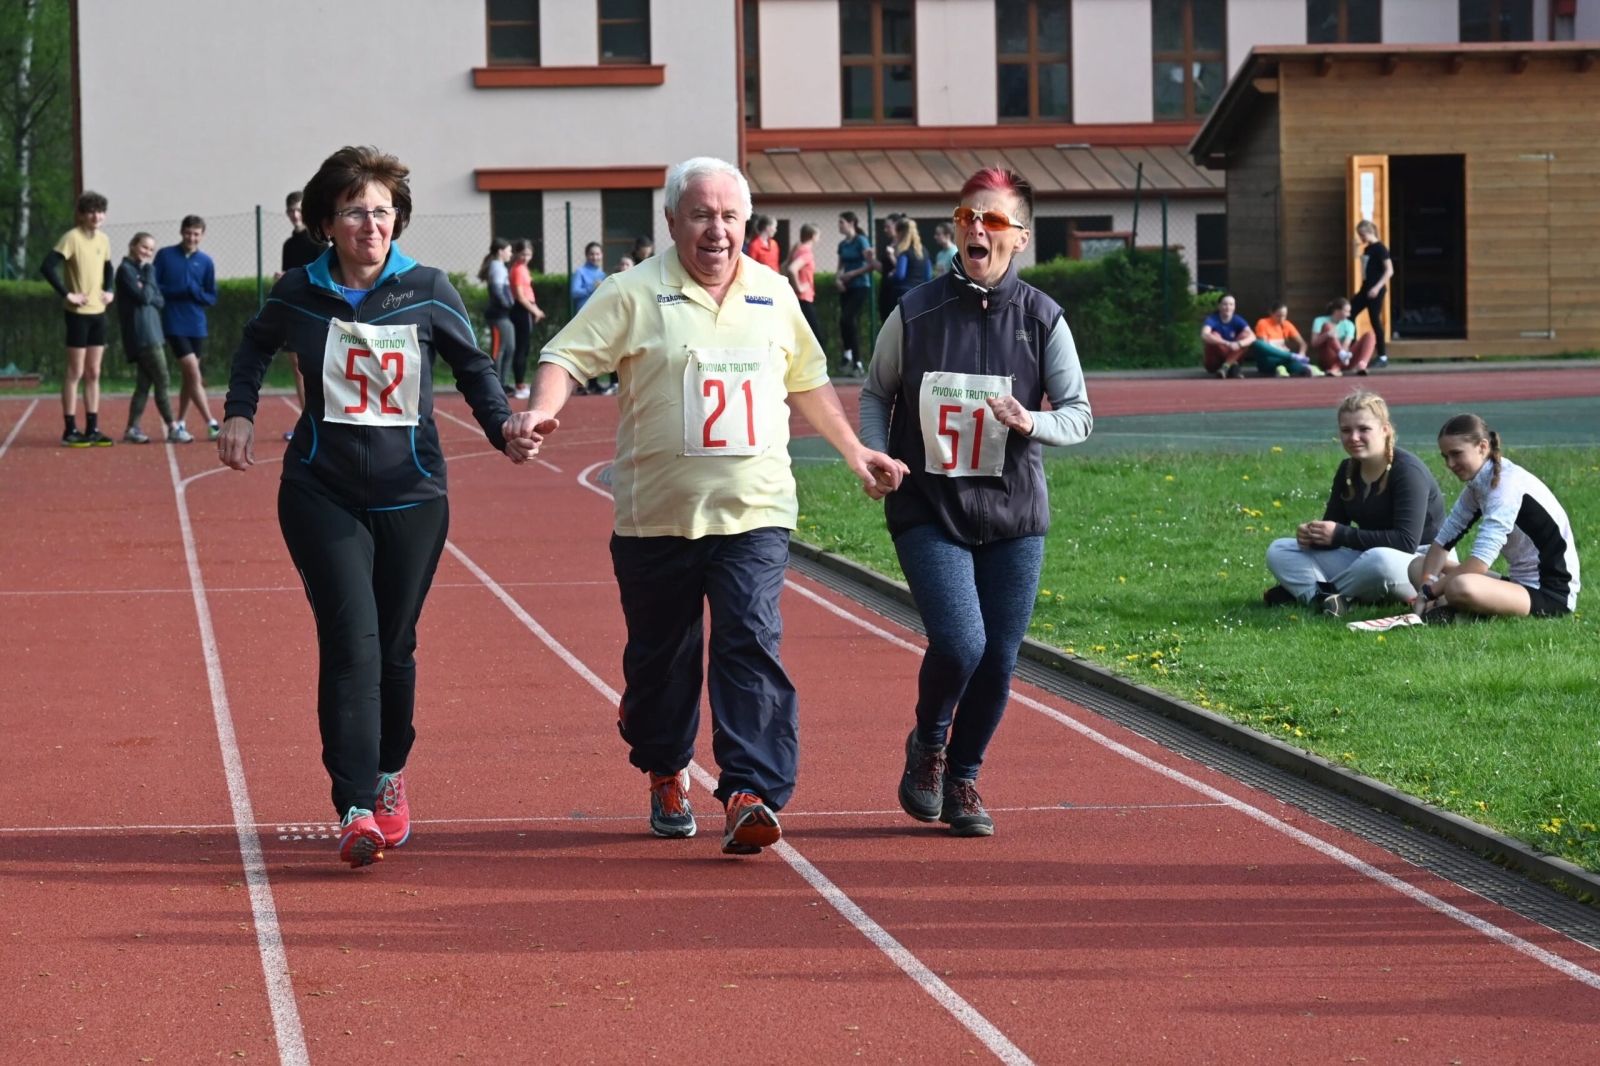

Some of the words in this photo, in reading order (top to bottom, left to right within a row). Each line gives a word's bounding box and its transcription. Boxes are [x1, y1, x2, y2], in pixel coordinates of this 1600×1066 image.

[370, 339, 406, 349] TRUTNOV
[344, 348, 404, 415] 52
[697, 361, 727, 373] PIVOVAR
[729, 361, 762, 373] TRUTNOV
[931, 385, 963, 398] PIVOVAR
[703, 379, 756, 447] 21
[938, 404, 985, 471] 51
